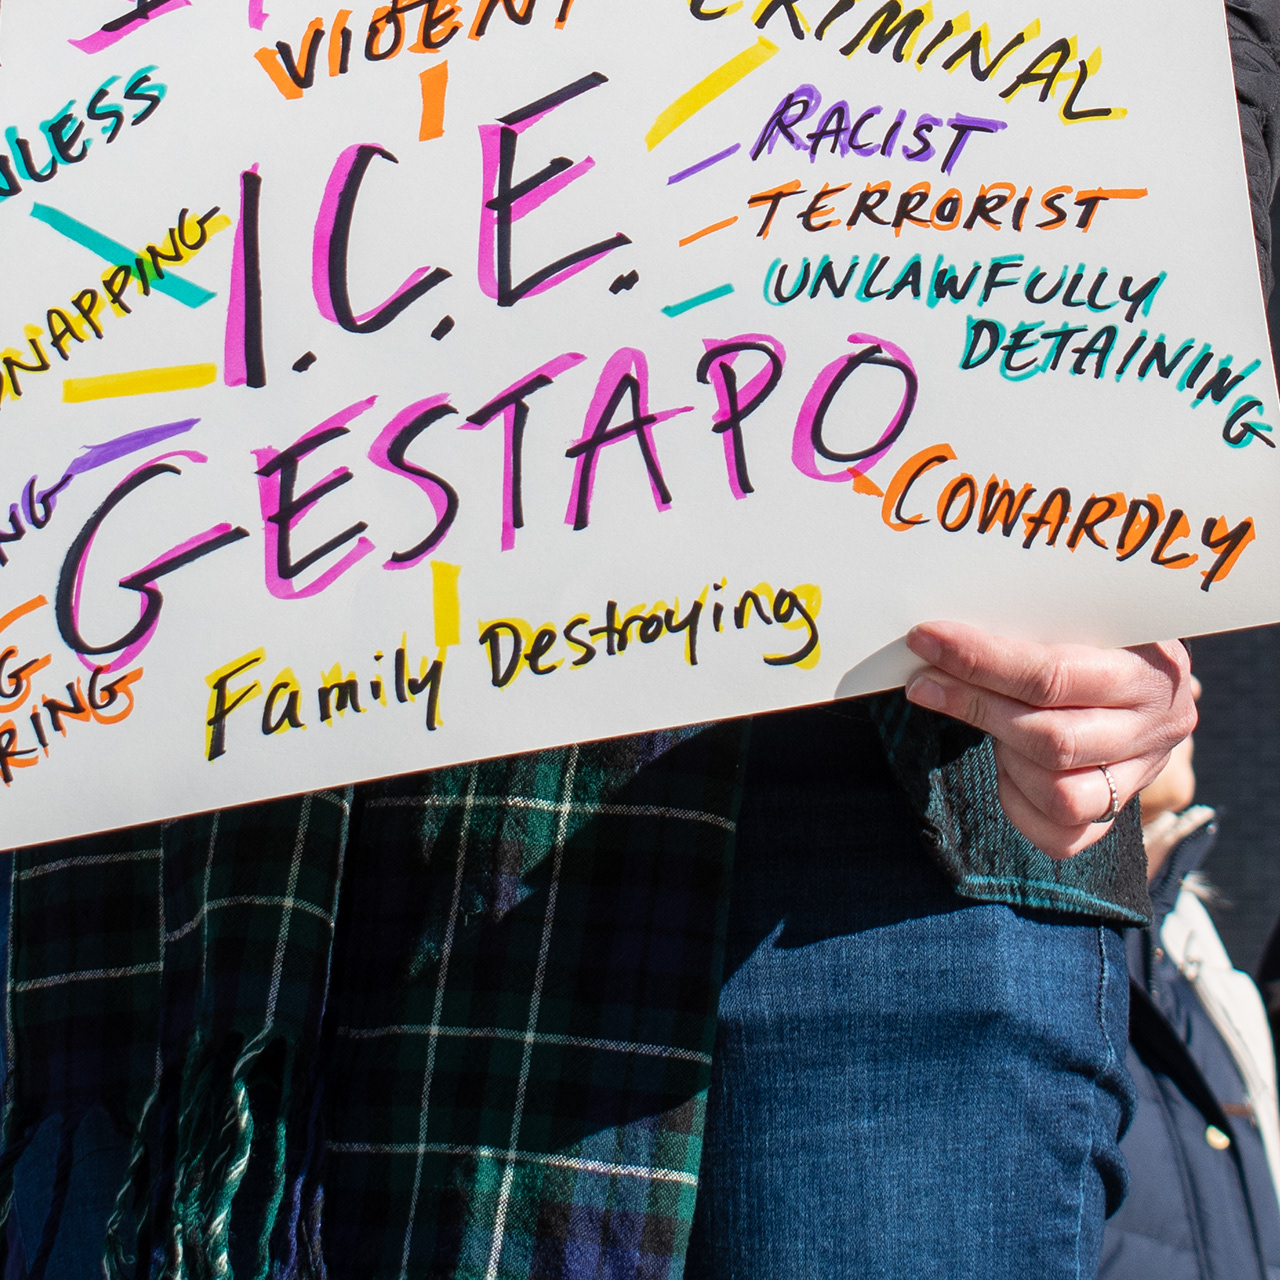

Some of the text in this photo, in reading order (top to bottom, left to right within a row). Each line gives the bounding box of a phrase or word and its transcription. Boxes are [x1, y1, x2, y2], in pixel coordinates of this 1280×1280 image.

[750, 84, 1007, 175] RACIST
[224, 72, 639, 388] I.C.E.
[747, 180, 1148, 240] TERRORIST
[763, 252, 1168, 319] UNLAWFULLY
[958, 316, 1276, 450] DETAINING
[55, 332, 919, 668] GESTAPO
[882, 443, 1255, 592] COWARDLY
[204, 577, 822, 763] Family Destroying
